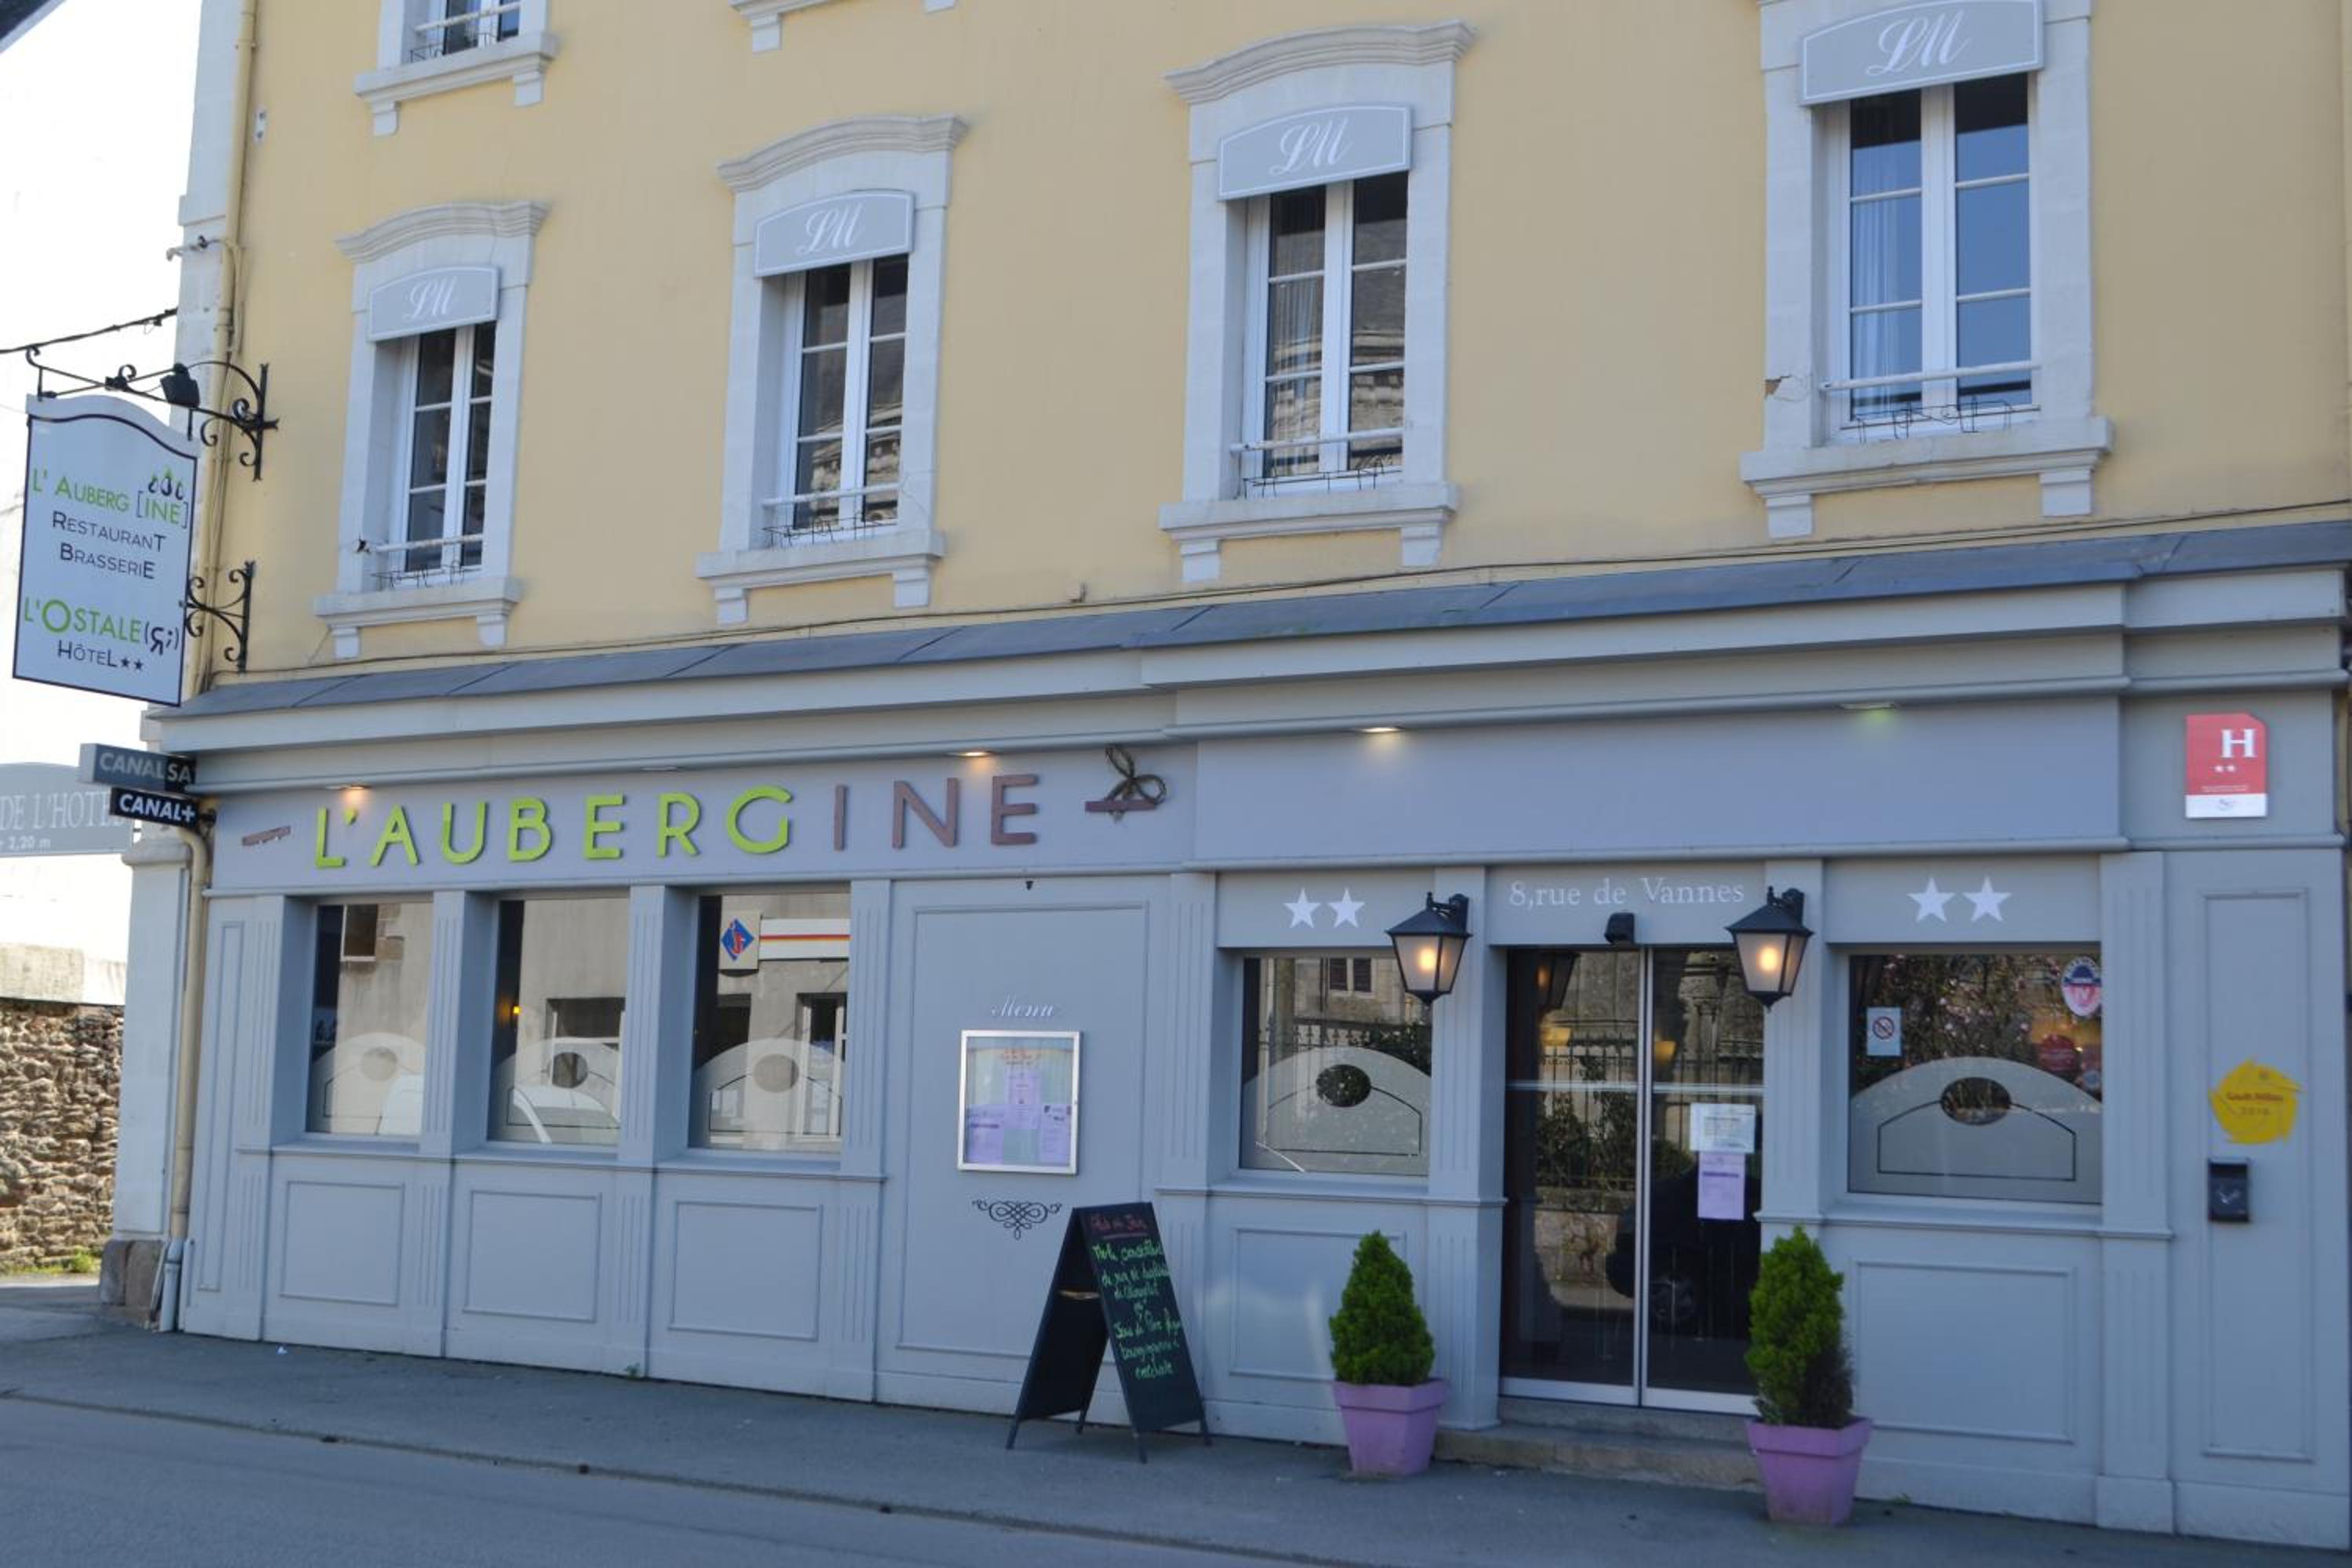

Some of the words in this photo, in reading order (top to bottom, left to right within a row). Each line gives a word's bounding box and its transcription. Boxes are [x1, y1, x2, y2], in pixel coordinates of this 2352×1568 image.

[54, 476, 129, 512] AUBERG
[53, 510, 166, 553] RESTAURANT
[60, 543, 155, 579] BRASSERIE
[2220, 728, 2258, 758] H
[0, 794, 25, 830] DE
[33, 791, 125, 829] L'HOTE
[119, 793, 196, 823] CANAL+
[316, 775, 1038, 867] L'AUBERGINE
[1594, 877, 1627, 905] de
[1639, 877, 1744, 905] Vannes
[991, 993, 1054, 1018] Menu
